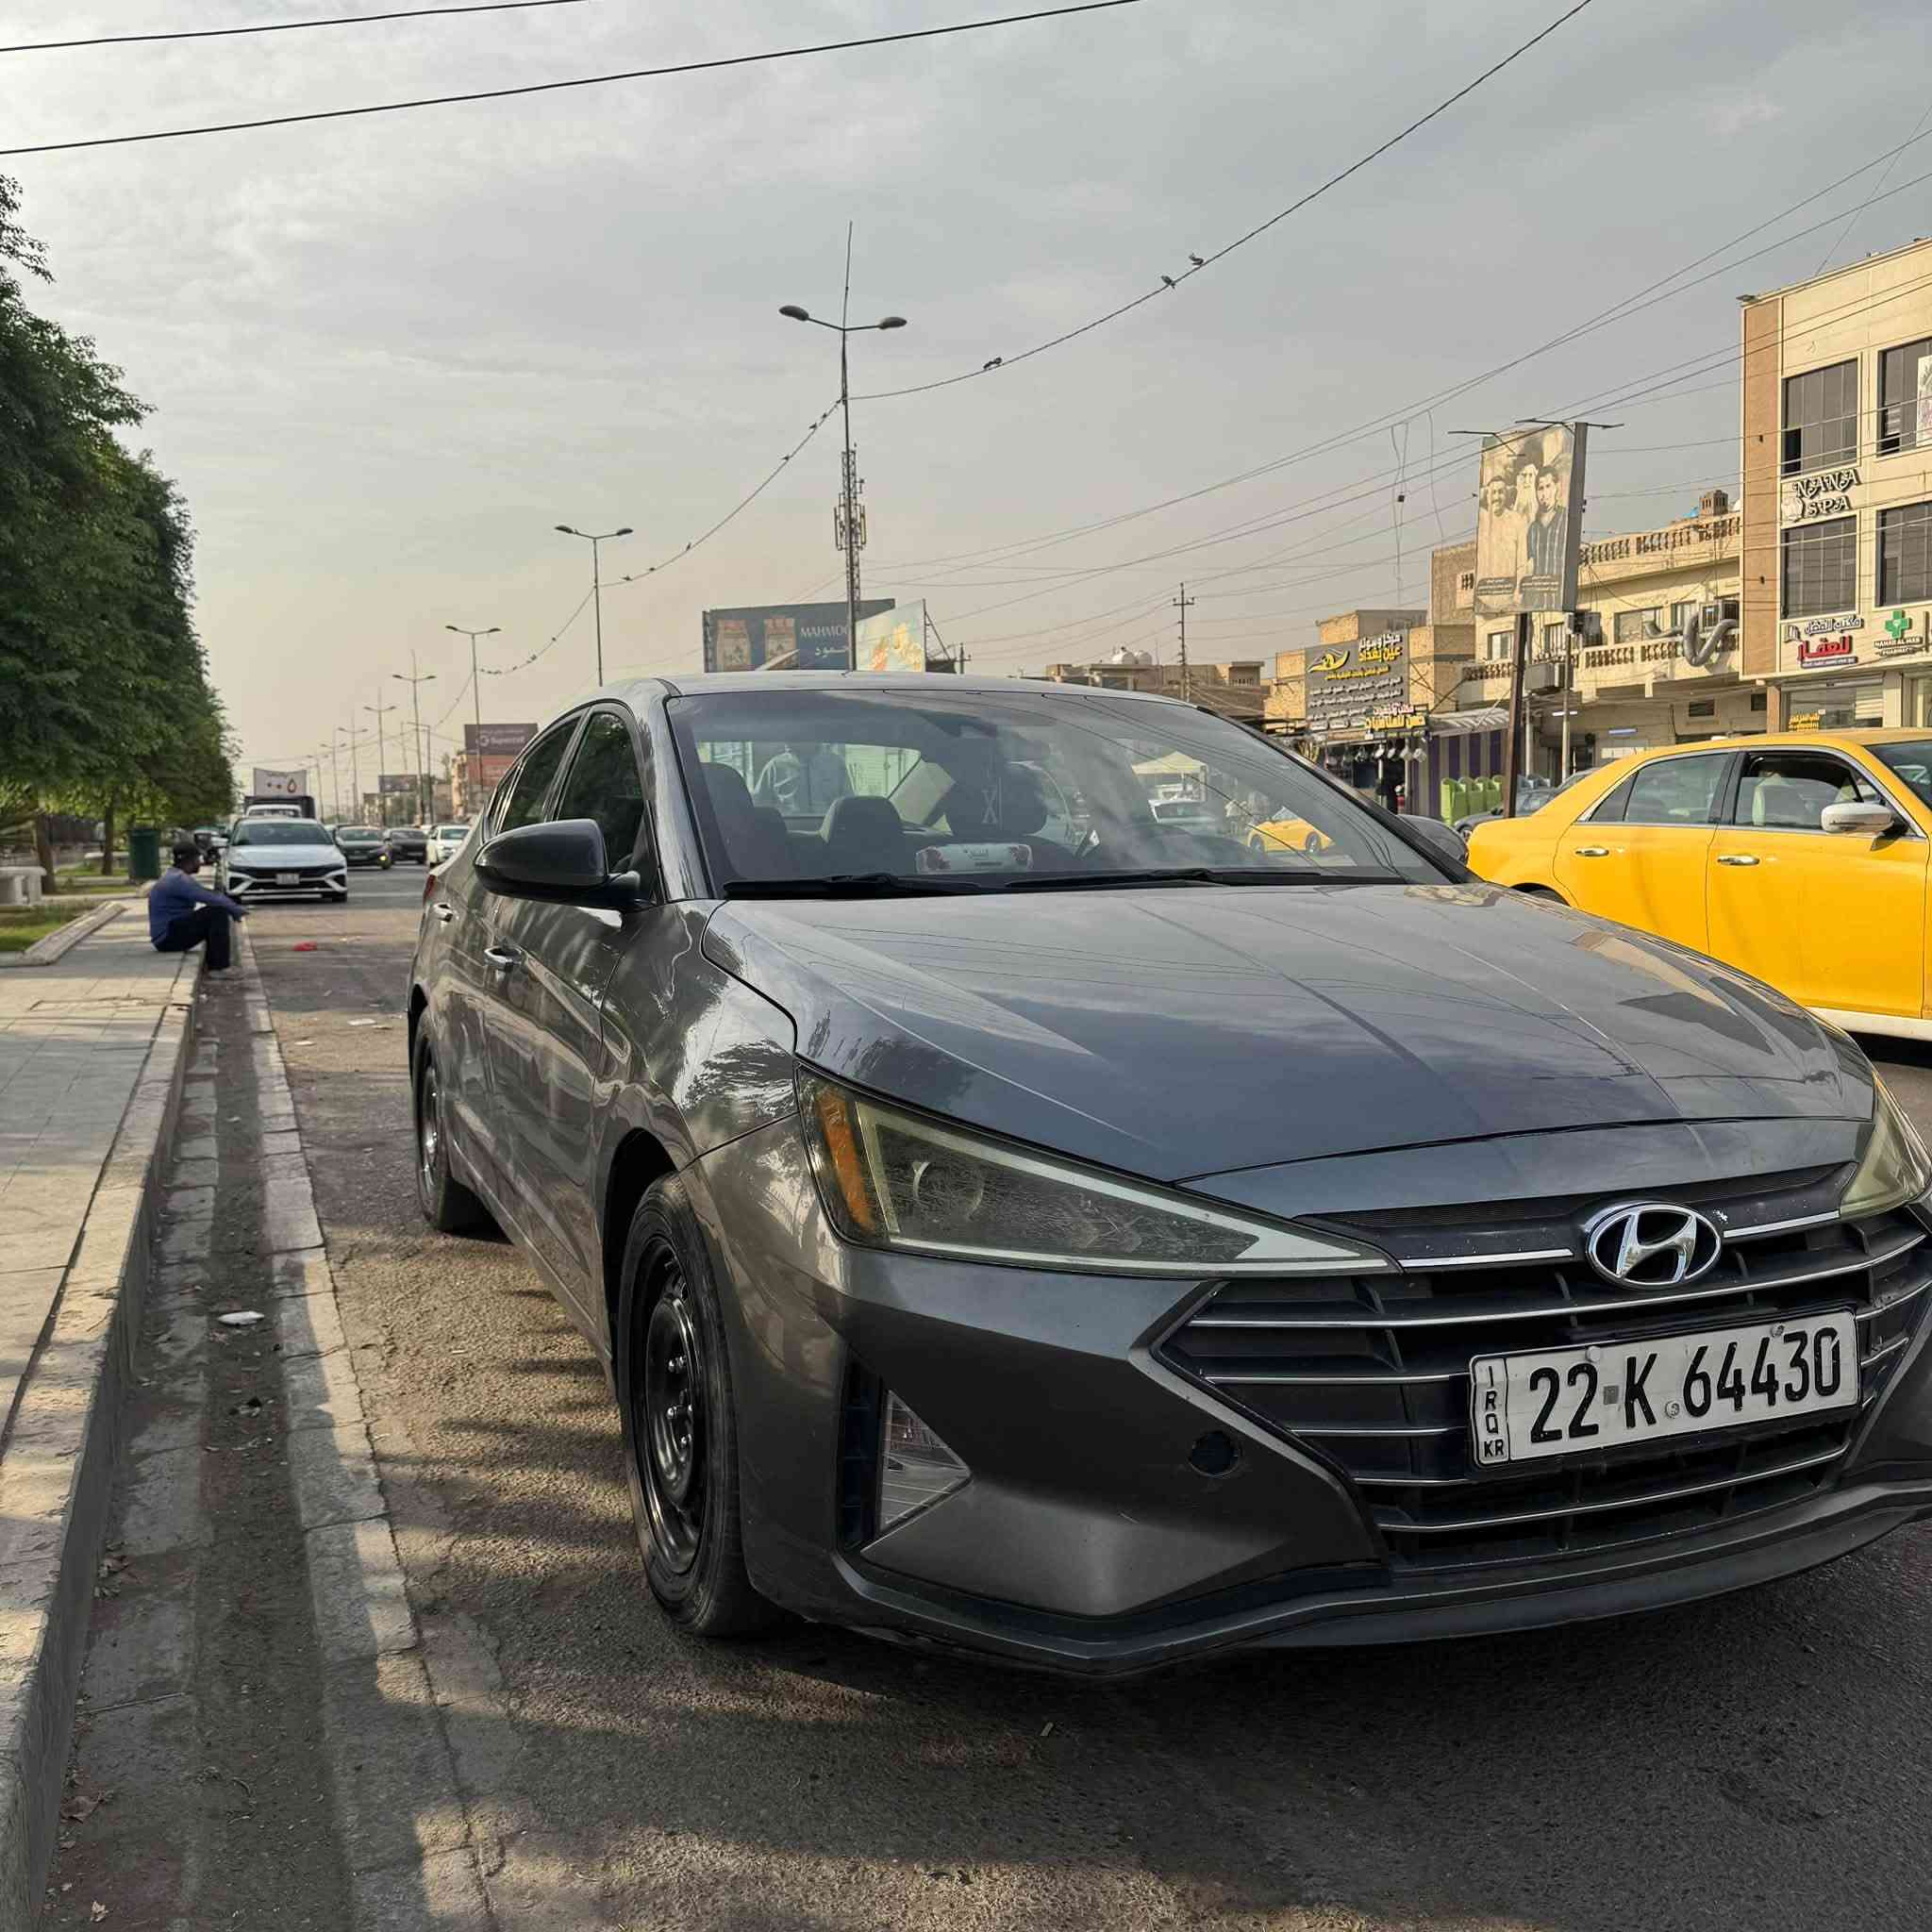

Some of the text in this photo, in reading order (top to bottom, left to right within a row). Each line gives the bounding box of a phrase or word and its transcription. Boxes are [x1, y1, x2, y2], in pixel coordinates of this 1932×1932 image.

[1796, 467, 1858, 498] NANA
[1807, 496, 1849, 518] SPA
[1529, 1326, 1841, 1443] 22 K 64430
[1484, 1439, 1504, 1457] KR
